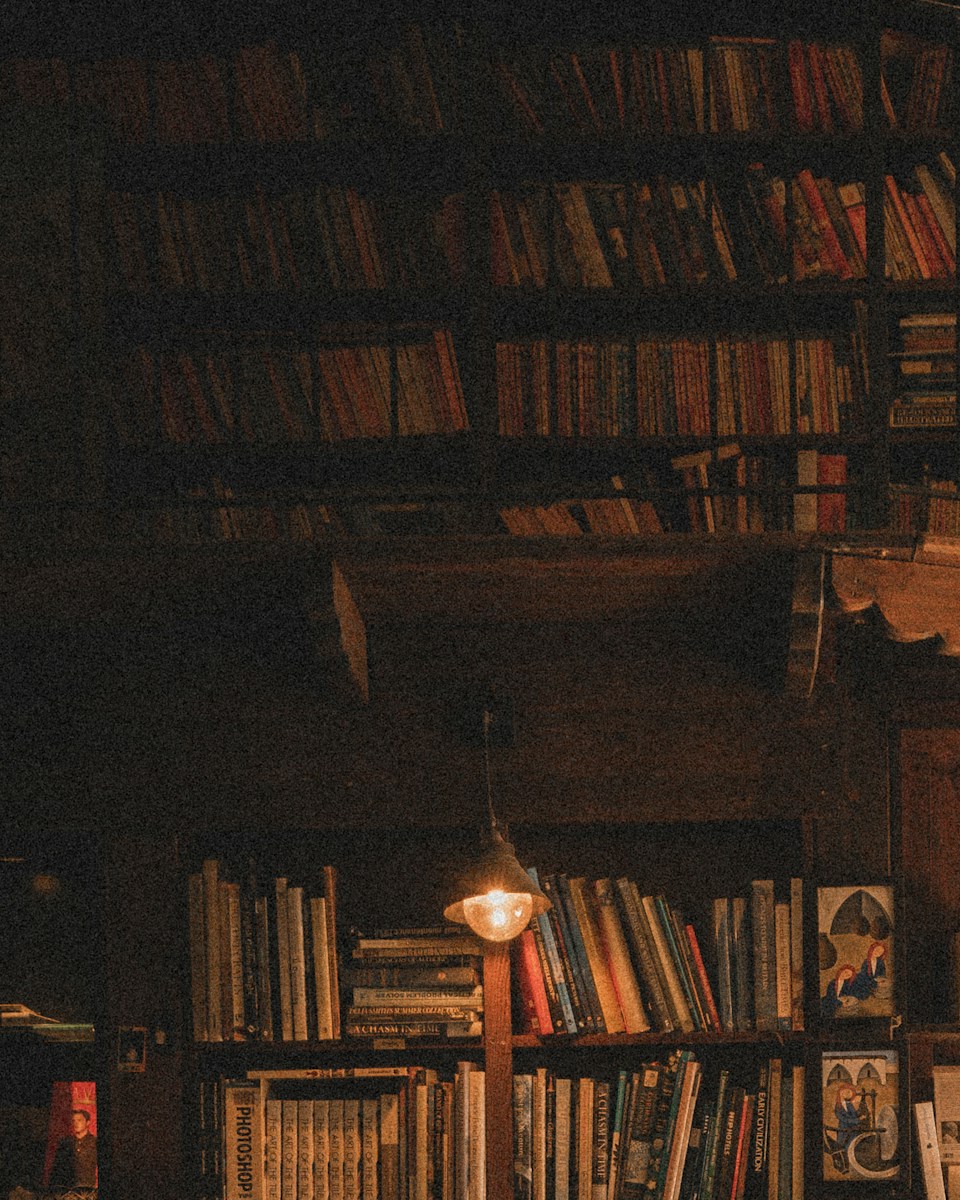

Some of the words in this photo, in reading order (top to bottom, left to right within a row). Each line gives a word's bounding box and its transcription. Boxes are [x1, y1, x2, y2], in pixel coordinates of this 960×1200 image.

[598, 1099, 606, 1137] CHASM
[757, 1092, 766, 1117] EARLY
[236, 1107, 253, 1192] PHOTOSHOP
[754, 1117, 764, 1173] CIVILIZATION
